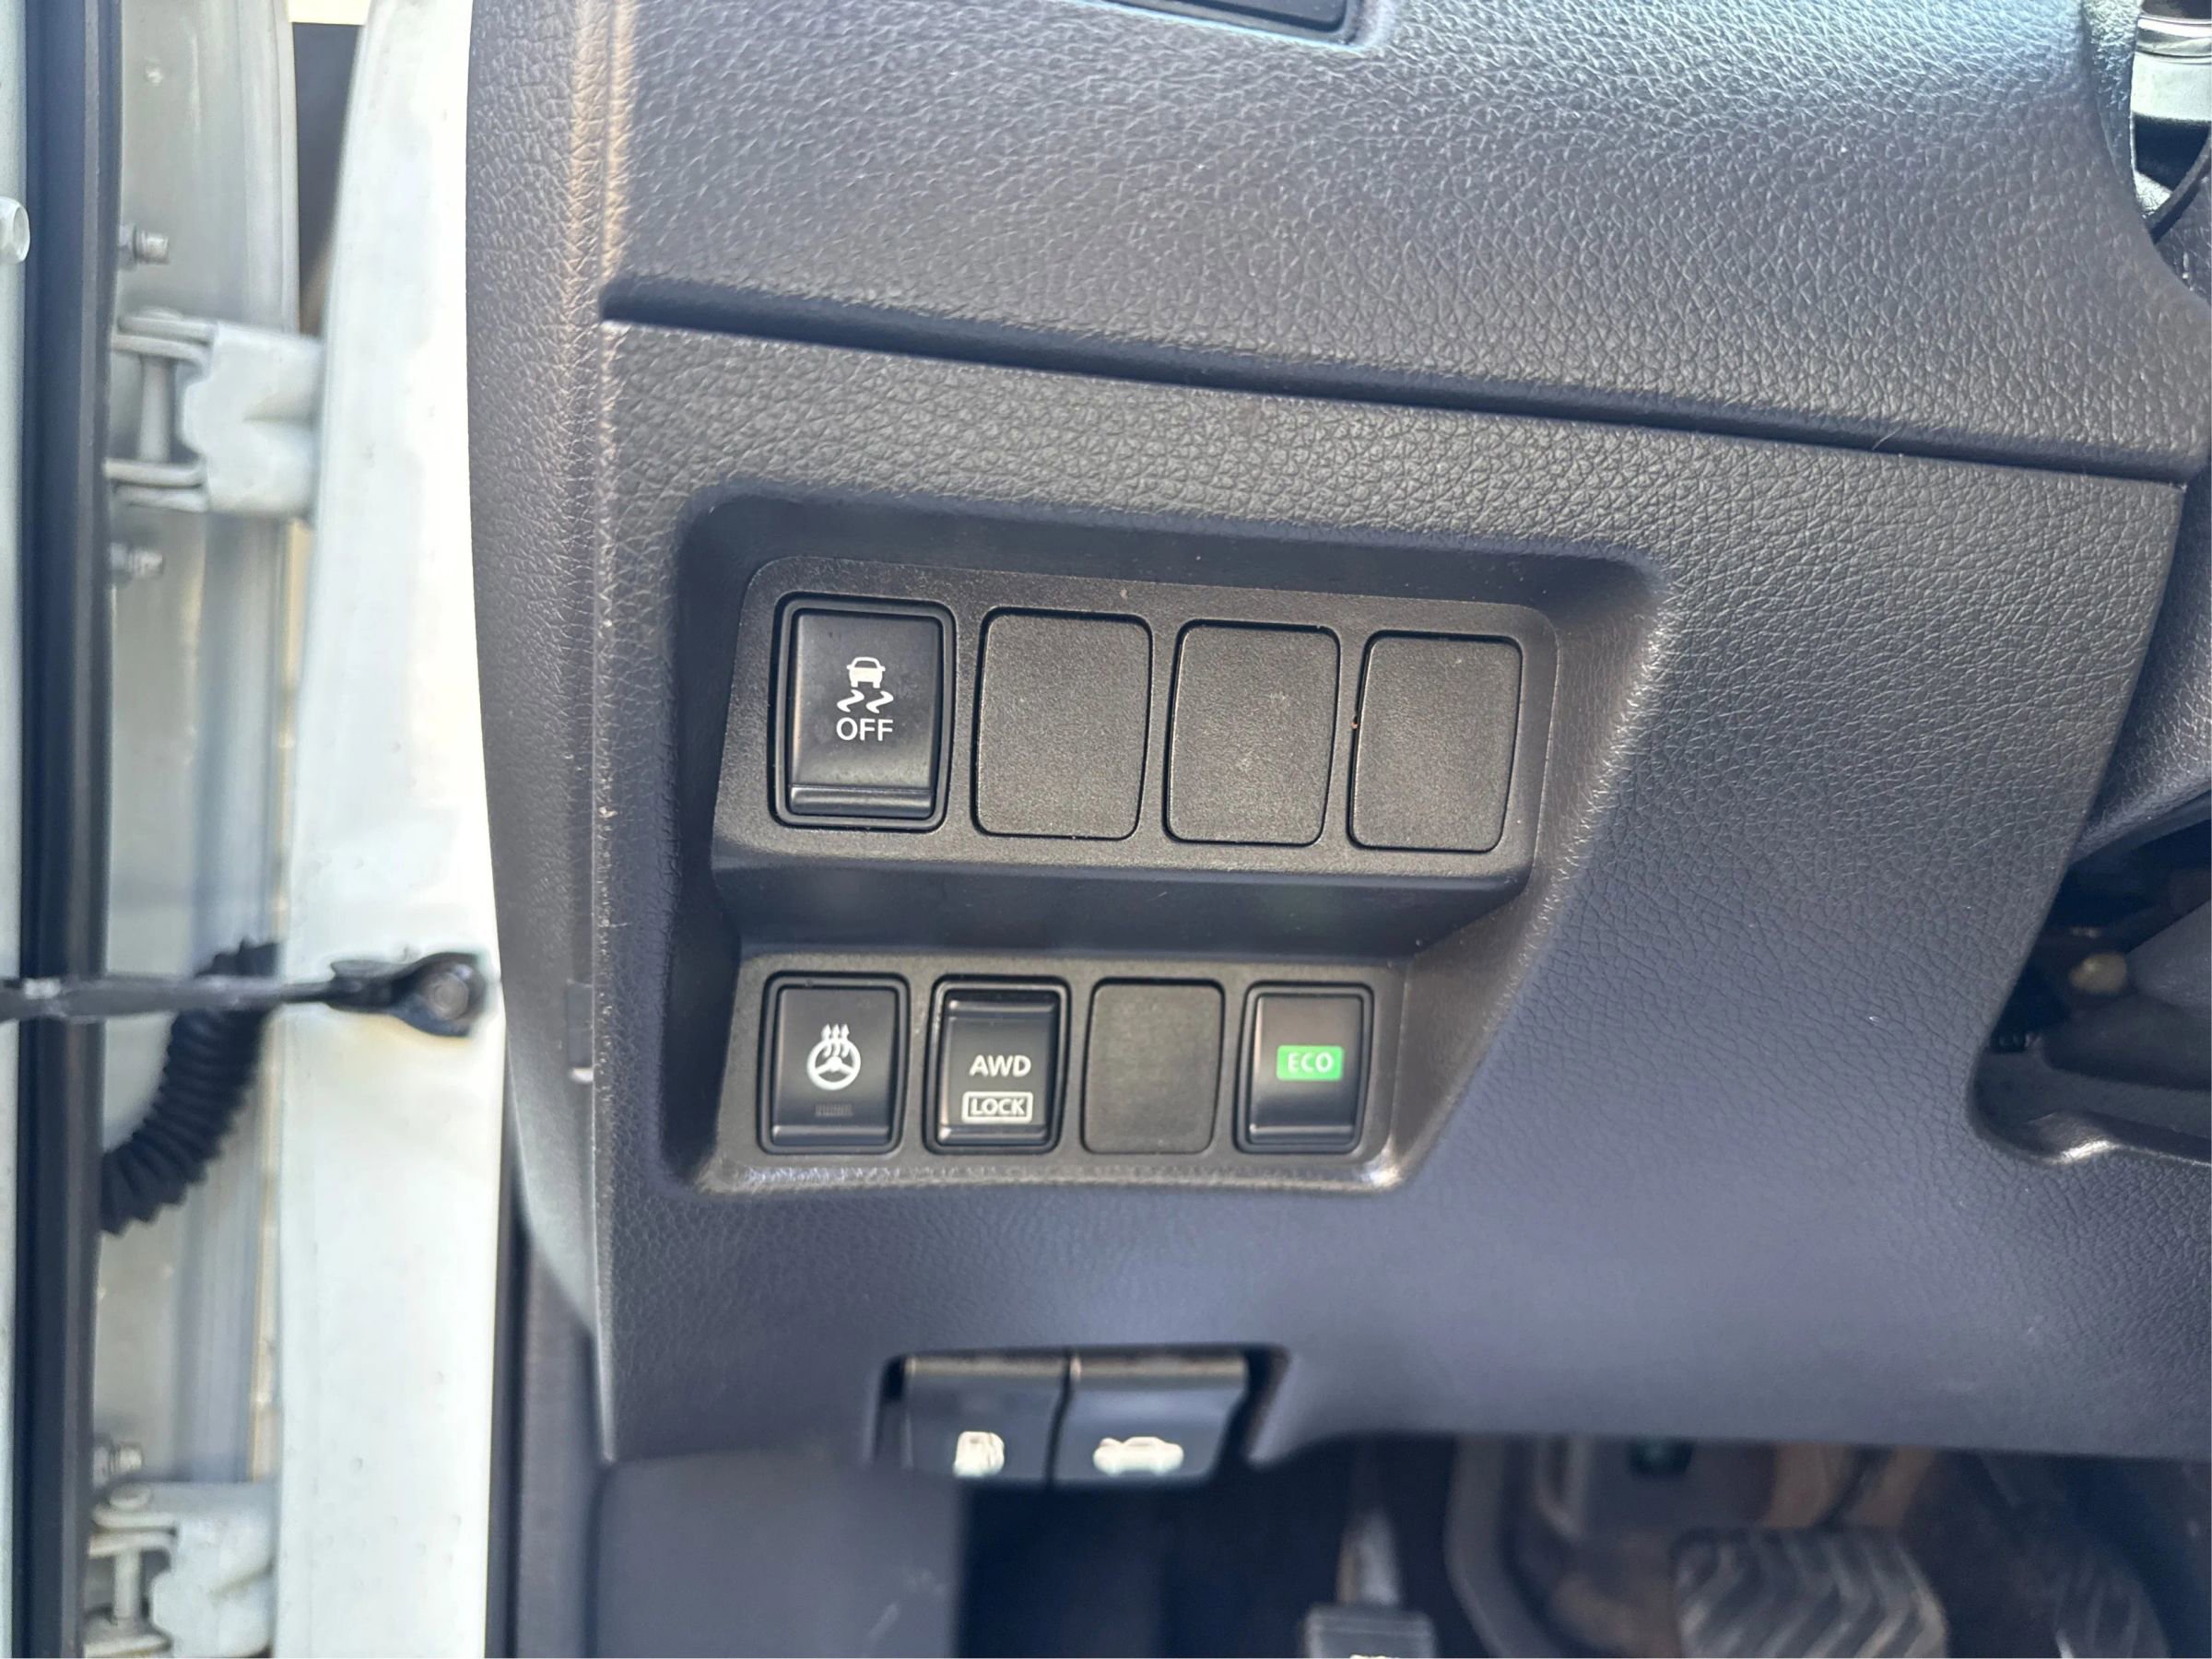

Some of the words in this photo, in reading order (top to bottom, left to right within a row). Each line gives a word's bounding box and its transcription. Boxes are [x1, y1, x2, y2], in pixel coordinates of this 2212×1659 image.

[836, 717, 894, 741] OFF
[970, 1054, 1031, 1077] AWD
[1288, 1052, 1334, 1073] ECO
[971, 1098, 1025, 1115] LOCK
